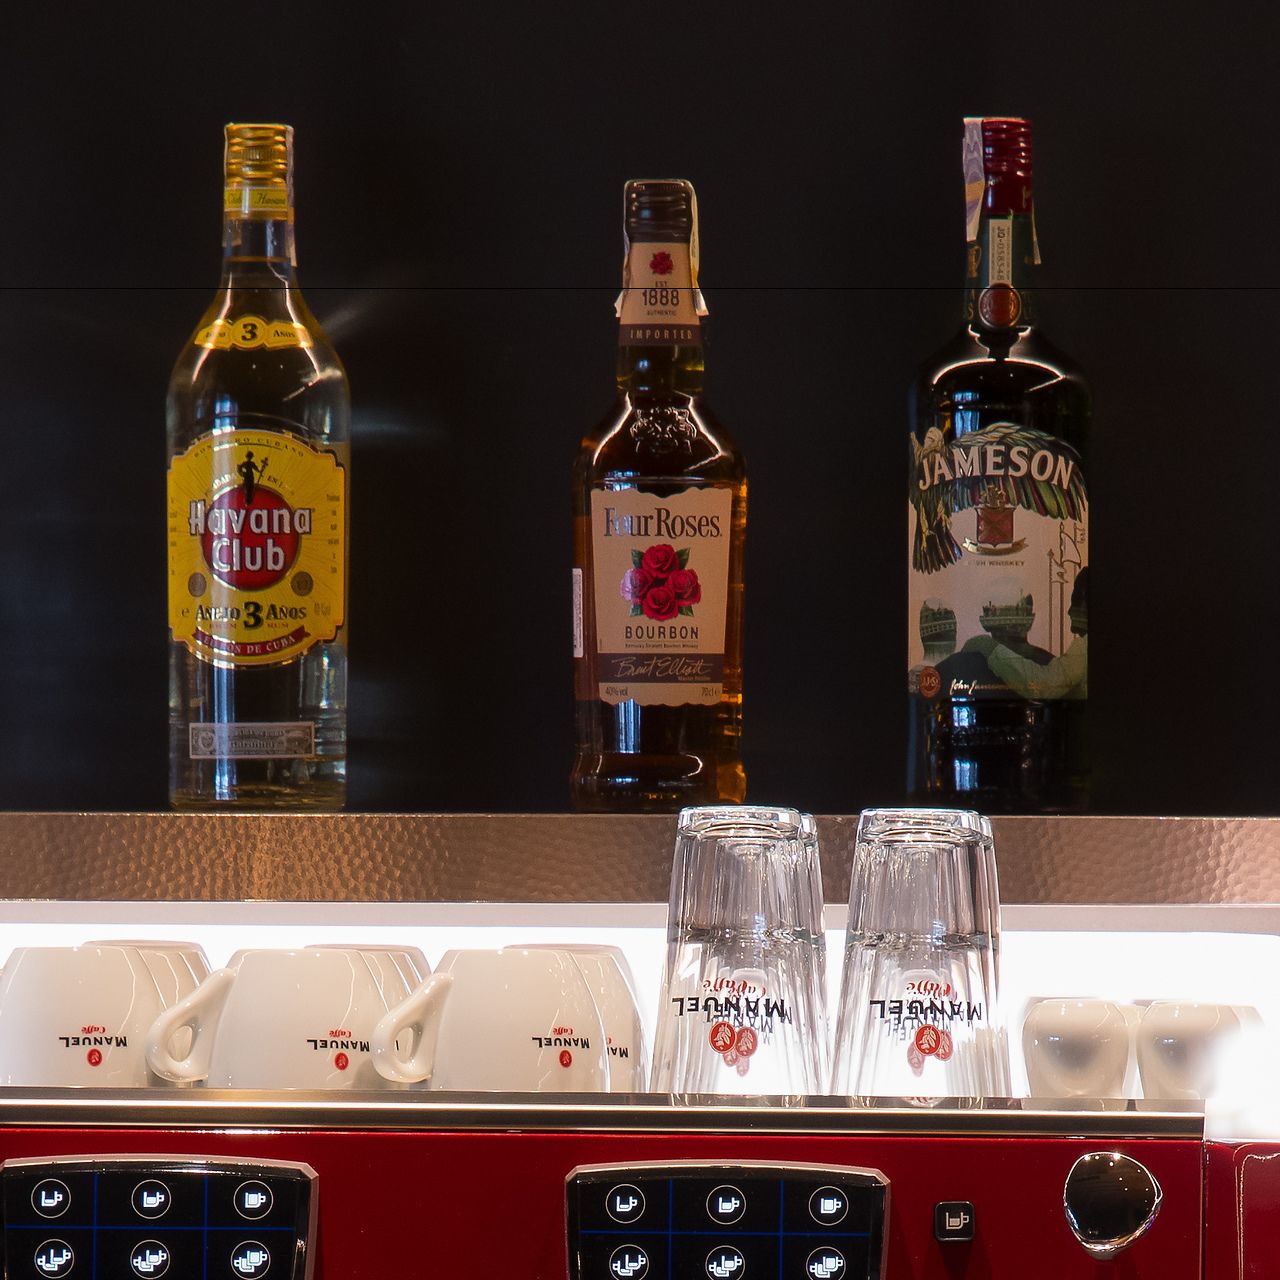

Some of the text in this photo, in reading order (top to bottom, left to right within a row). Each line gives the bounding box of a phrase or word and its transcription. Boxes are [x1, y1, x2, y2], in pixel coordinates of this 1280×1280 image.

[642, 289, 680, 307] 1888
[241, 322, 258, 342] 3
[630, 328, 693, 340] IMPORTED
[919, 445, 1075, 491] JAMESON
[188, 500, 312, 537] Havana
[211, 537, 286, 572] Club
[243, 601, 264, 630] 3
[625, 626, 699, 640] BOURBON
[246, 644, 262, 654] DE
[266, 635, 296, 652] CUBA
[672, 997, 785, 1018] MANUEL
[870, 999, 982, 1020] MANUEL
[58, 1036, 128, 1048] MANUEL
[306, 1039, 370, 1052] MANUEL
[532, 1037, 590, 1049] MANUEL
